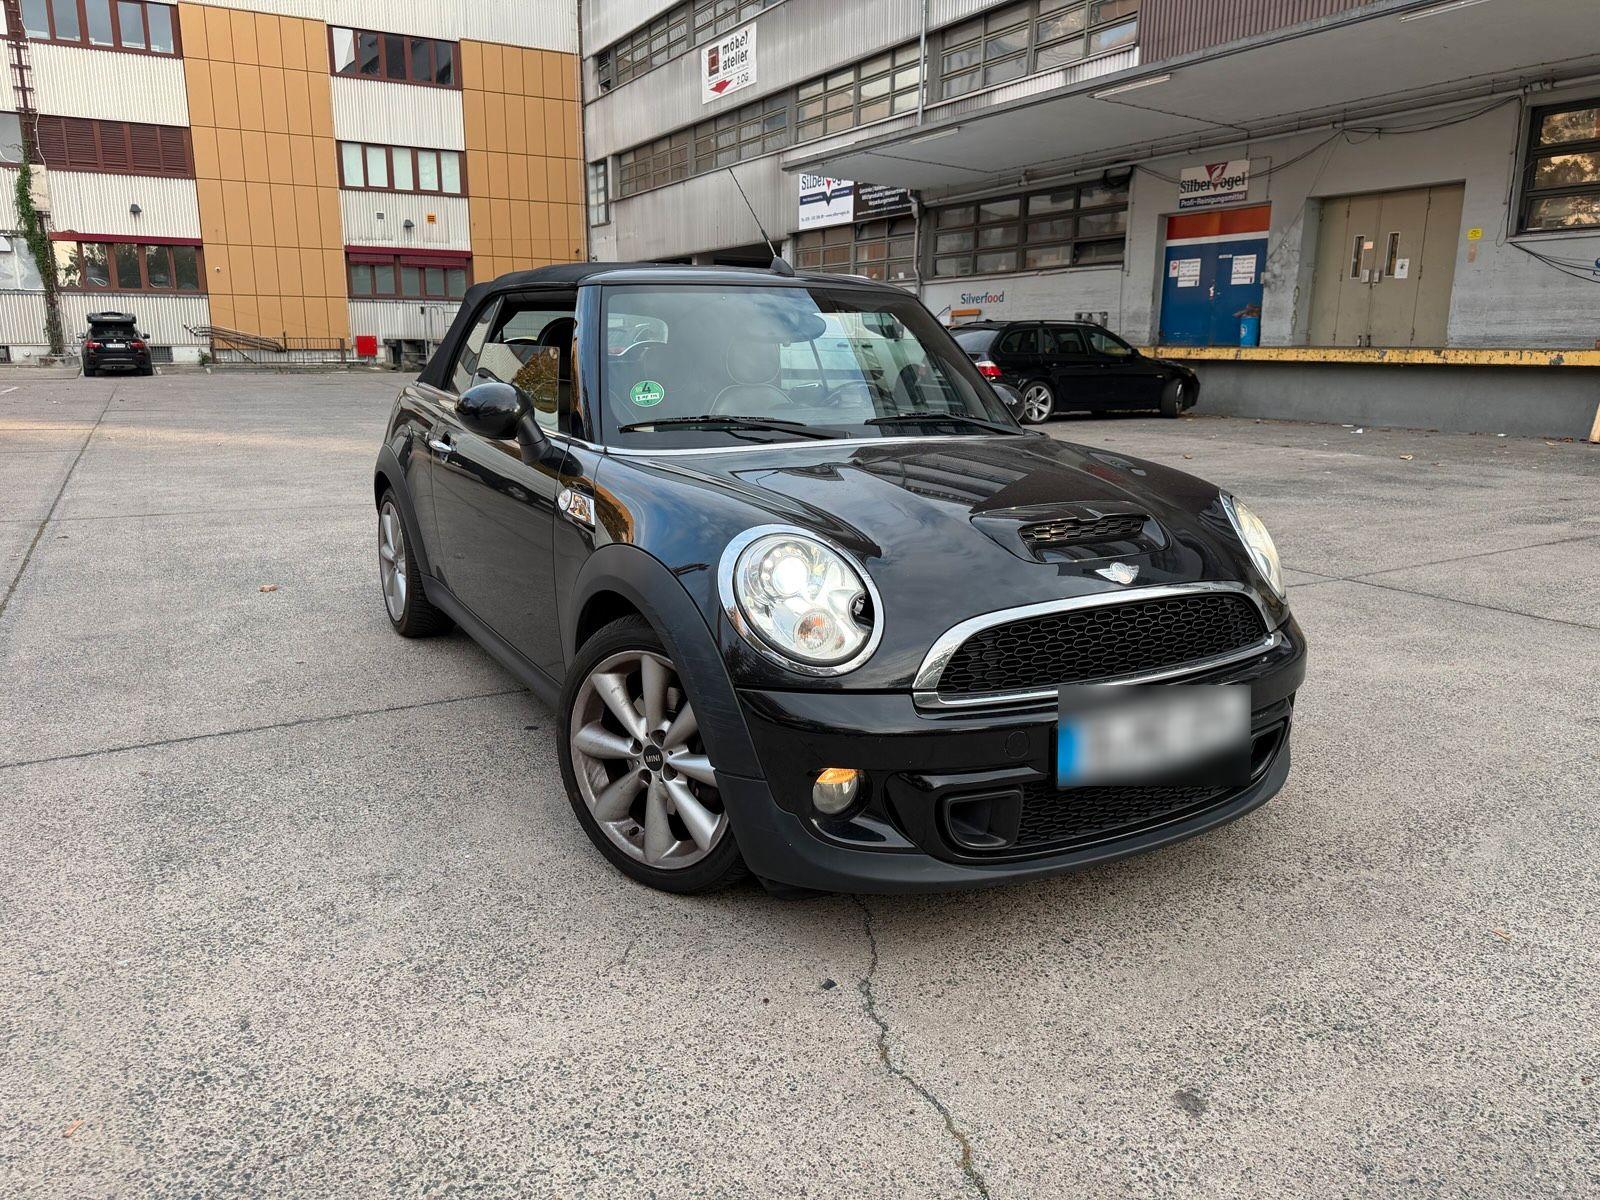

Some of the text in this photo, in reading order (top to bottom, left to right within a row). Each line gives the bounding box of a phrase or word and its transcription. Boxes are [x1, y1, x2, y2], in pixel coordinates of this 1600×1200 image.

[722, 30, 748, 55] möbel
[722, 49, 748, 71] atelier
[961, 291, 1005, 304] Silverfood
[642, 382, 651, 393] 4
[645, 754, 661, 763] MINI
